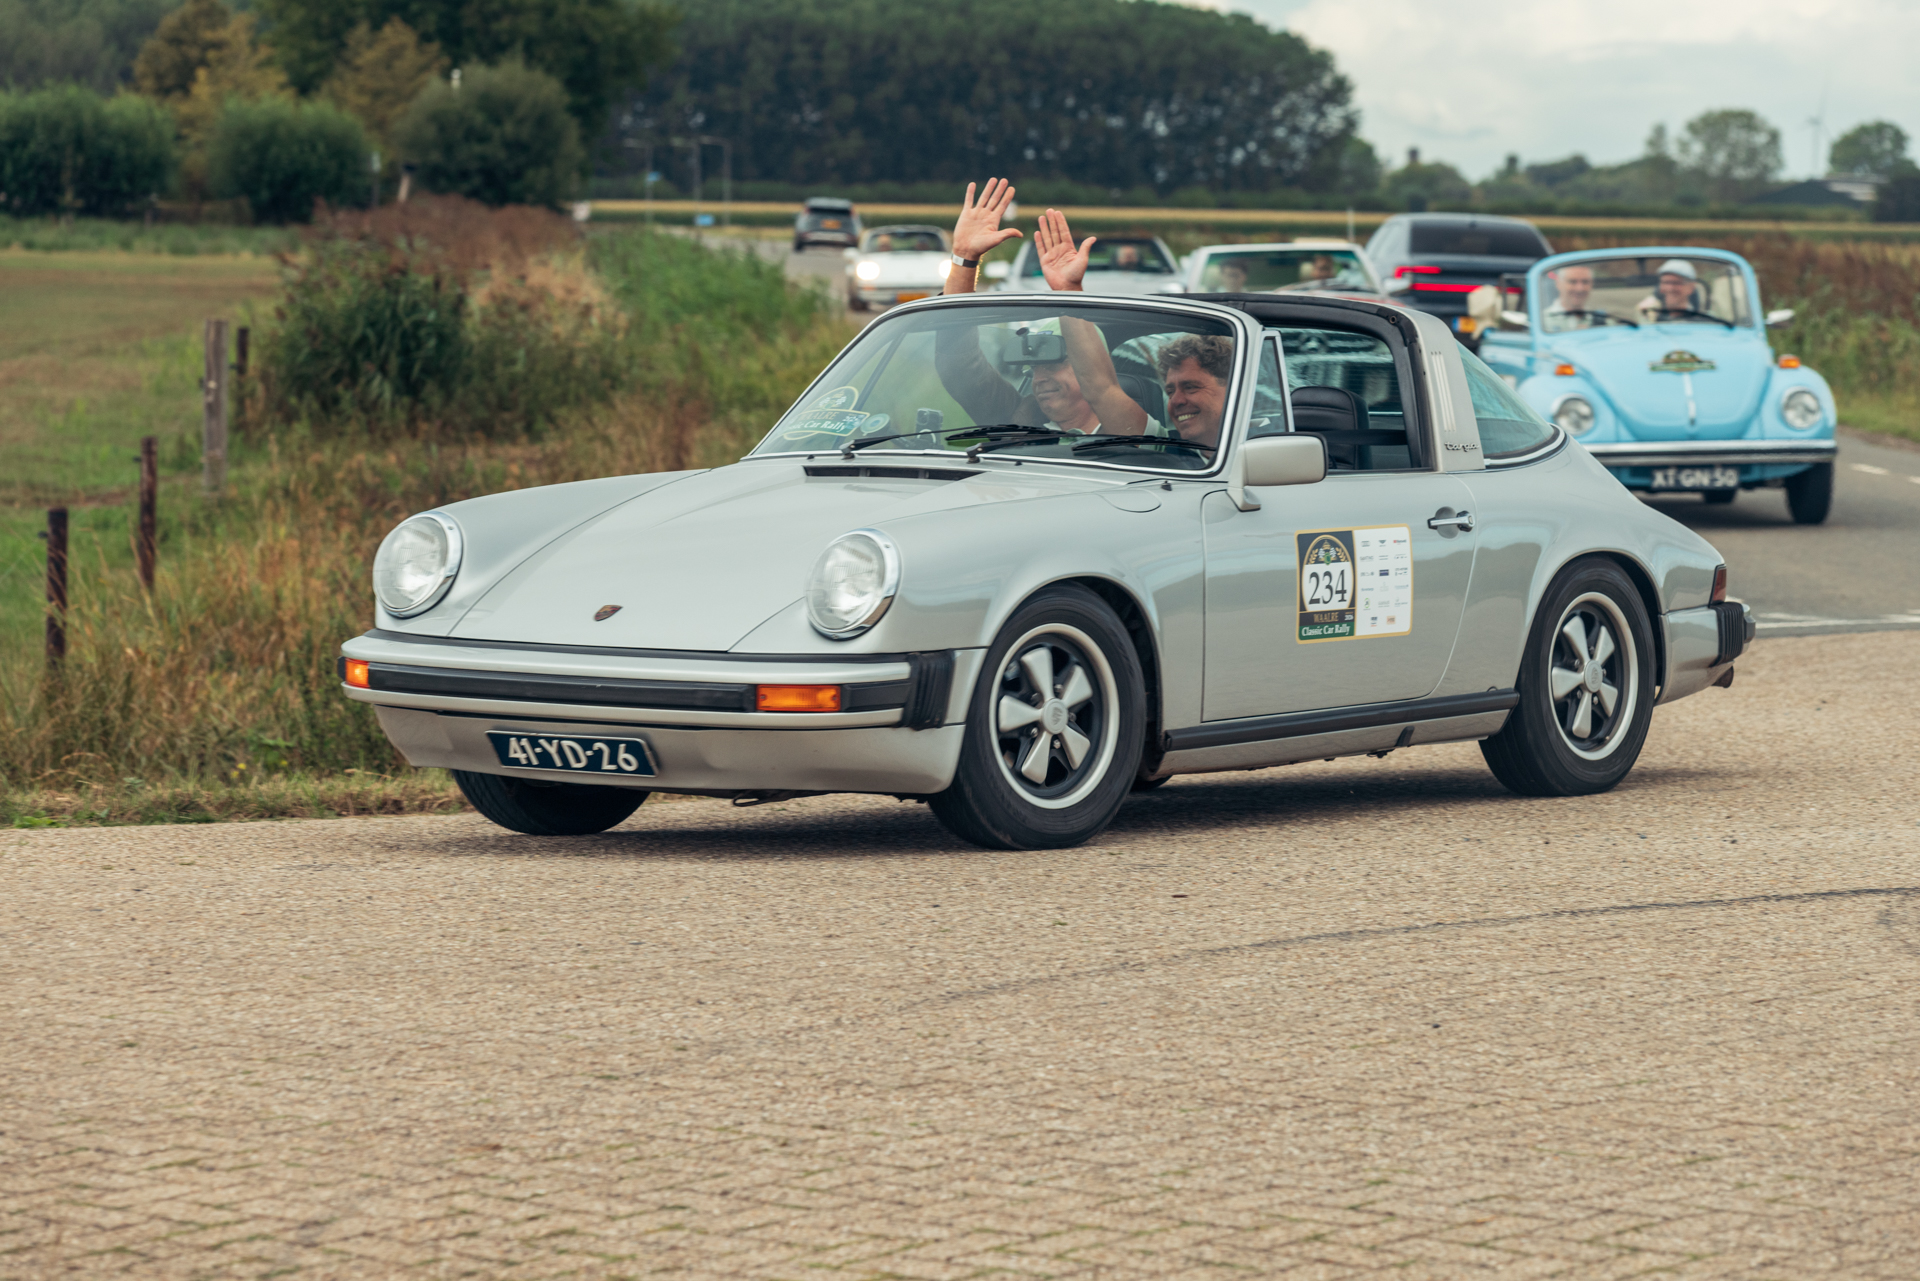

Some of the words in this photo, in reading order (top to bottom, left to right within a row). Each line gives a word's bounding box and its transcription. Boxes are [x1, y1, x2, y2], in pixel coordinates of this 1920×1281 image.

[804, 420, 821, 428] Car
[820, 420, 846, 433] Rally
[1444, 441, 1480, 453] targa
[1308, 568, 1347, 605] 234
[1313, 611, 1339, 623] WAALRE
[1301, 625, 1322, 636] Classic
[1323, 625, 1334, 635] Car
[1334, 623, 1351, 636] Rally
[508, 737, 640, 772] 41-YD-26
